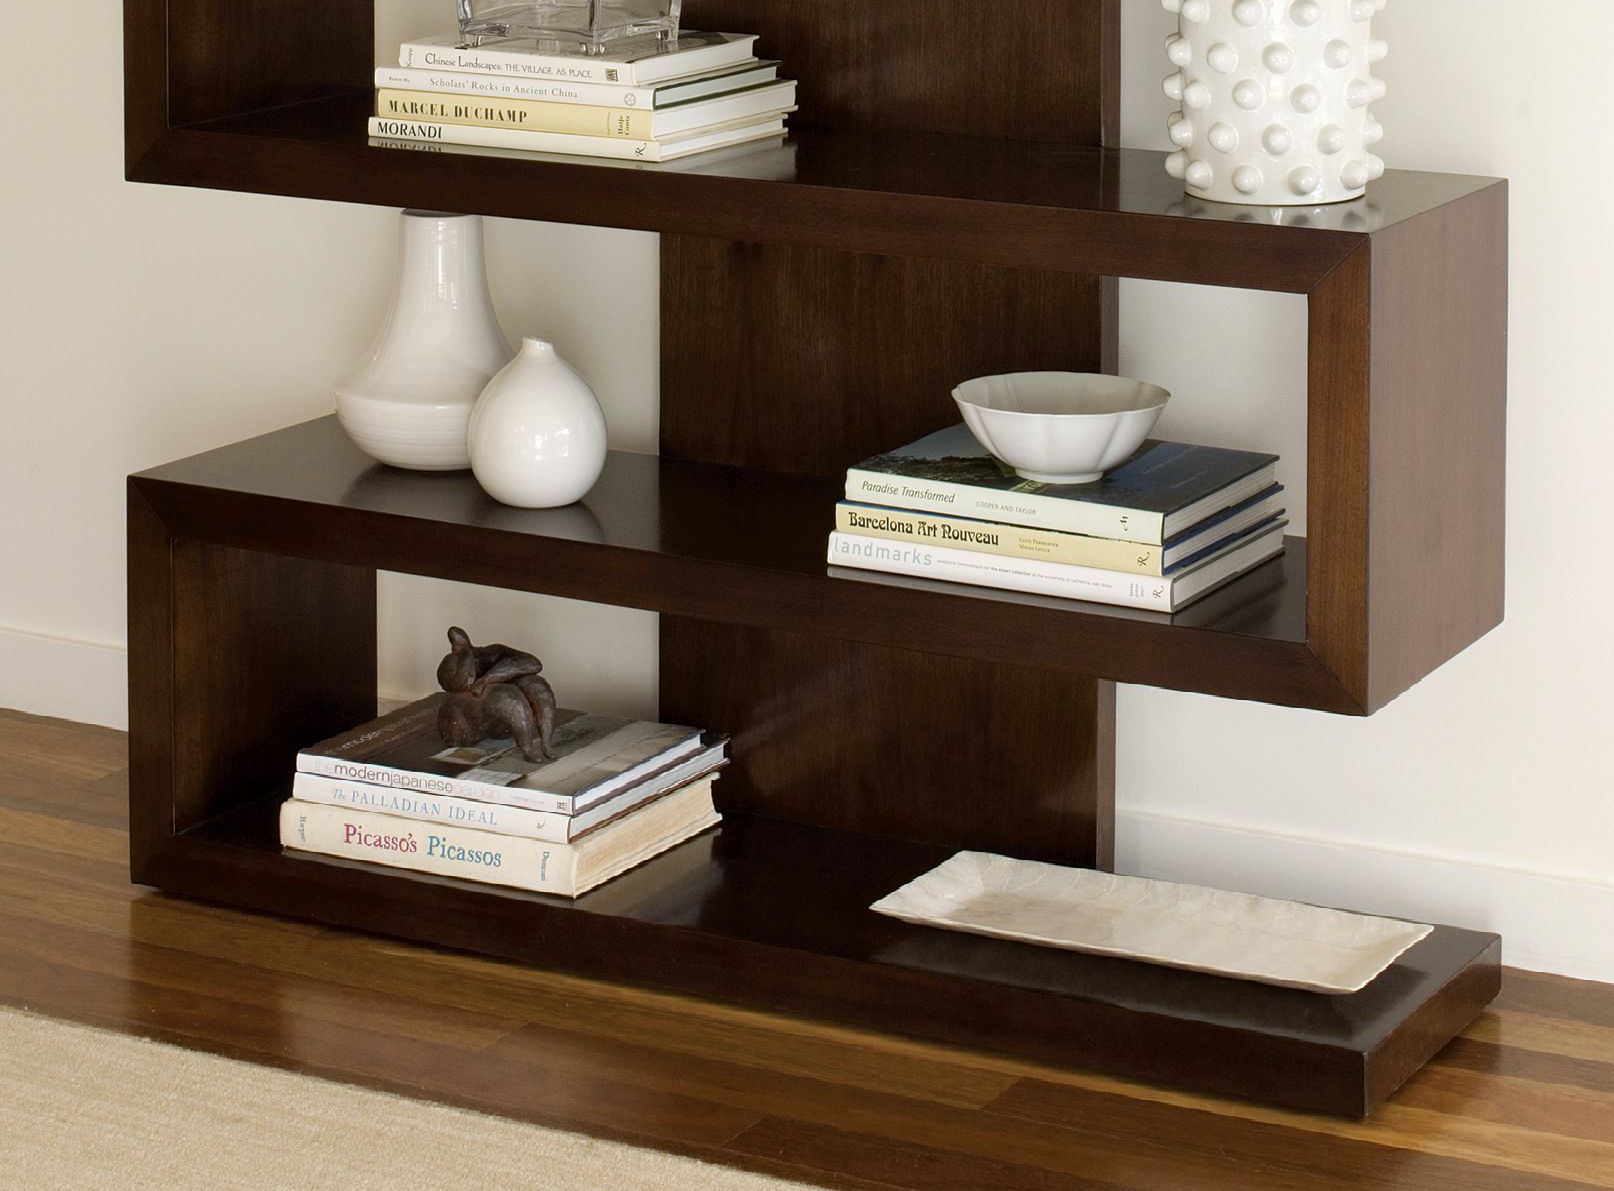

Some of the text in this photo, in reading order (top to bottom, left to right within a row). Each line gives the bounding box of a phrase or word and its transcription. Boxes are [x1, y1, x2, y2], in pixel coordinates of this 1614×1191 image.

[425, 52, 592, 78] Chinese Landscapes: THE VILLAGE AS PLACE
[471, 81, 498, 92] Rocks
[502, 84, 510, 92] in
[514, 87, 548, 96] Ancient
[552, 88, 578, 98] China
[389, 99, 528, 123] MARCEL DUCHAMP
[377, 121, 442, 139] MORANDI
[861, 480, 956, 503] Paradise Transformed
[976, 500, 1036, 515] COOPER AND TAYLOR
[848, 511, 999, 546] Barcelona Art Nouveau
[834, 536, 933, 566] landmarks
[331, 788, 498, 826] The PALLADIAN IDEAL
[344, 823, 502, 867] Picasso's Picassos
